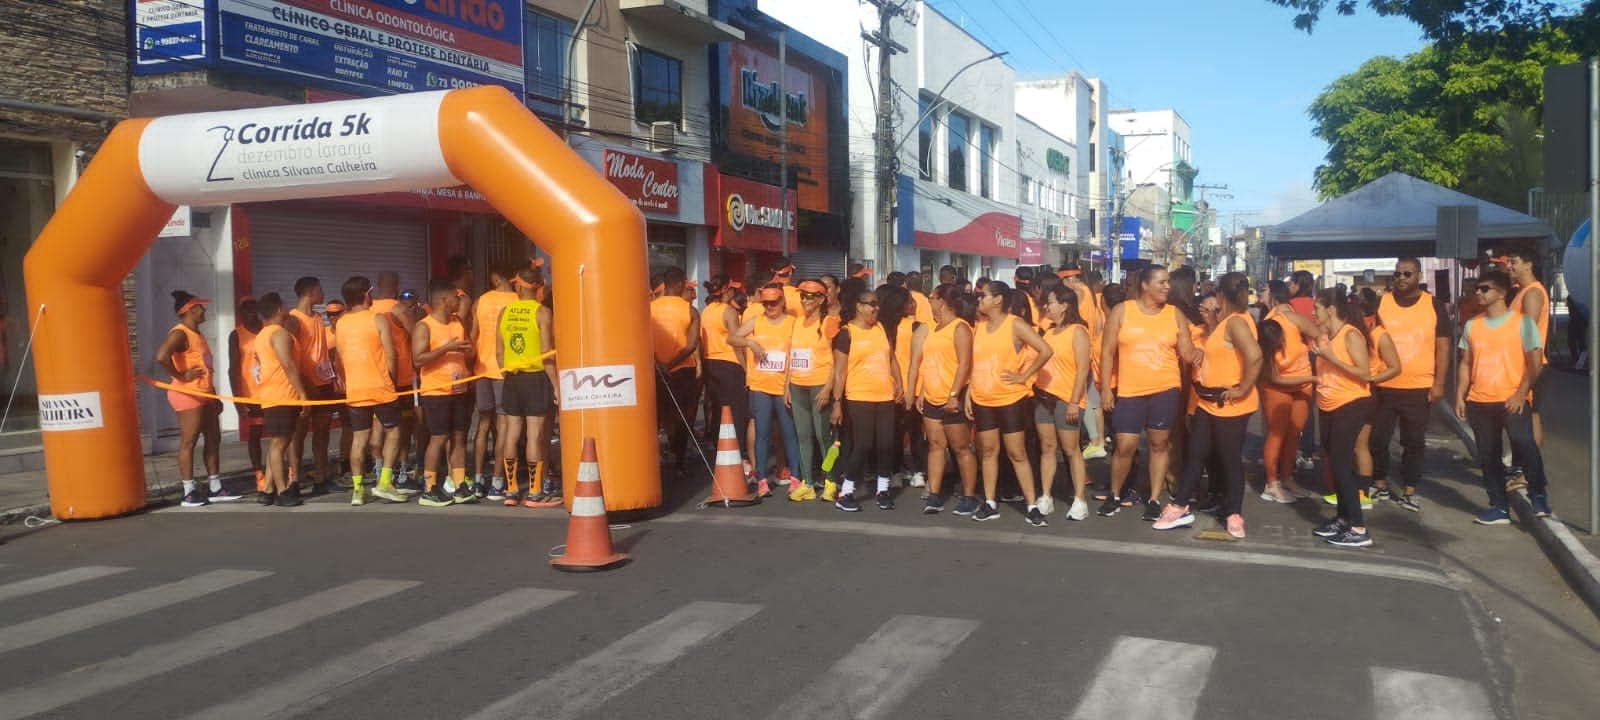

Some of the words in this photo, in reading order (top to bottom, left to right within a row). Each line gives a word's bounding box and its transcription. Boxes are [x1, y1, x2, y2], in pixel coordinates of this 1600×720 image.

[272, 6, 329, 32] CLÍNICO
[334, 22, 375, 43] GERAL
[375, 11, 456, 43] ODONTOLÓGICA
[238, 116, 333, 145] Corrida
[339, 112, 372, 138] 5k
[237, 145, 313, 165] dezembro
[317, 141, 373, 160] laranja
[607, 152, 646, 180] Moda
[281, 164, 325, 178] Silvana
[326, 160, 378, 176] Calheira
